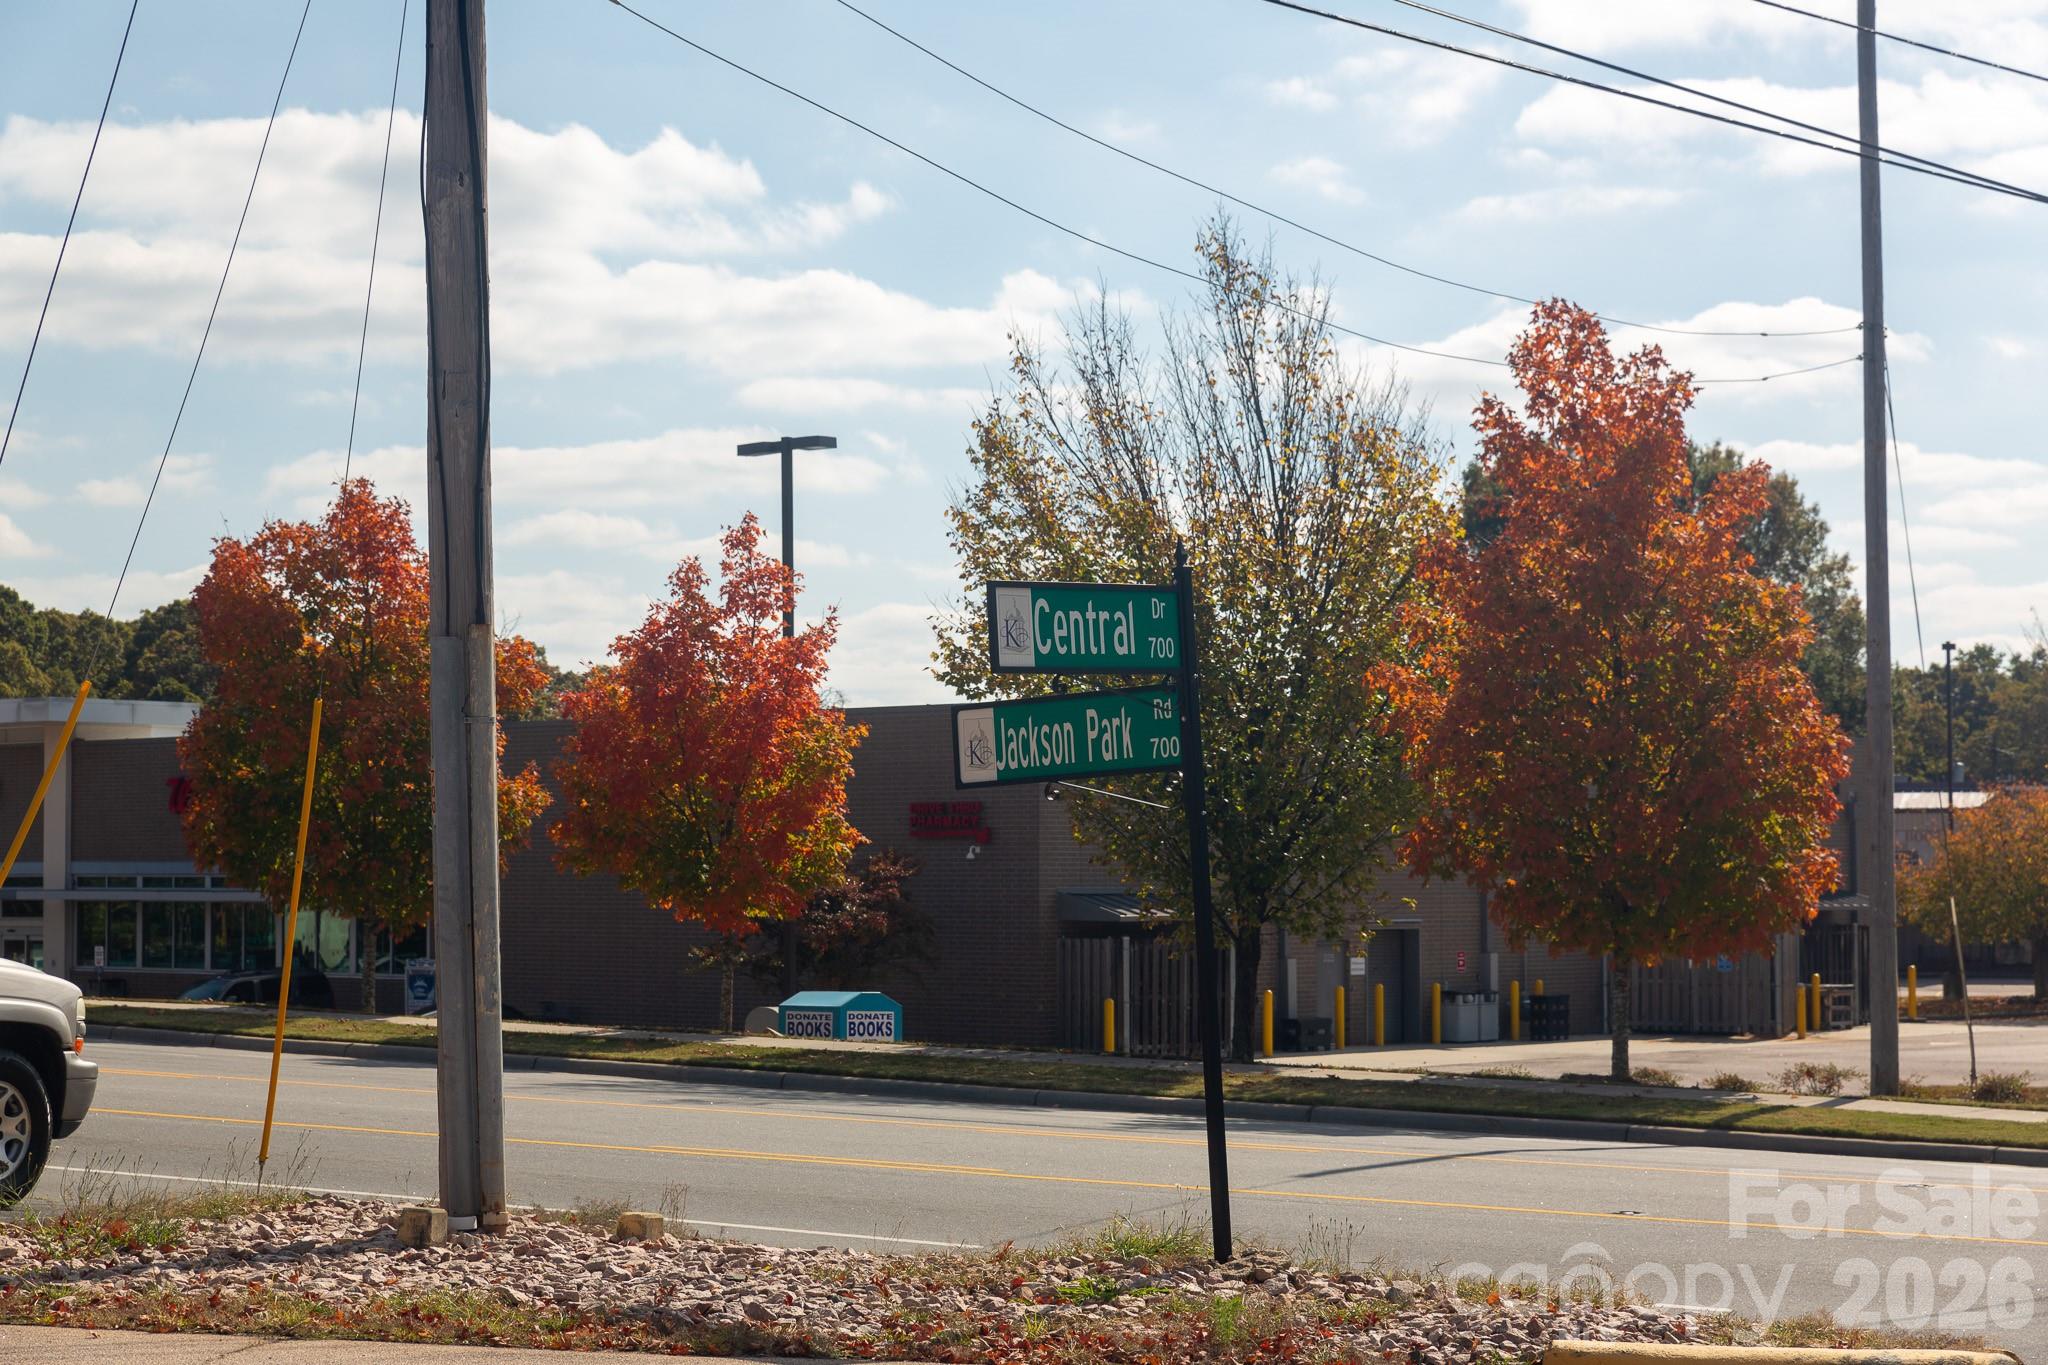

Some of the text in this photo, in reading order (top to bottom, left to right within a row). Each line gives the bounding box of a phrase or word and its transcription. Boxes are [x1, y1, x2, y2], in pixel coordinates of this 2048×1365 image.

[1034, 598, 1166, 655] Central Dr
[1149, 637, 1174, 659] 700
[997, 699, 1172, 770] Jackson Park Rd
[1150, 736, 1180, 759] 700
[787, 1013, 832, 1021] DONATE
[848, 1013, 893, 1021] DONATE
[788, 1021, 831, 1037] BOOKS
[849, 1021, 892, 1037] BOOKS
